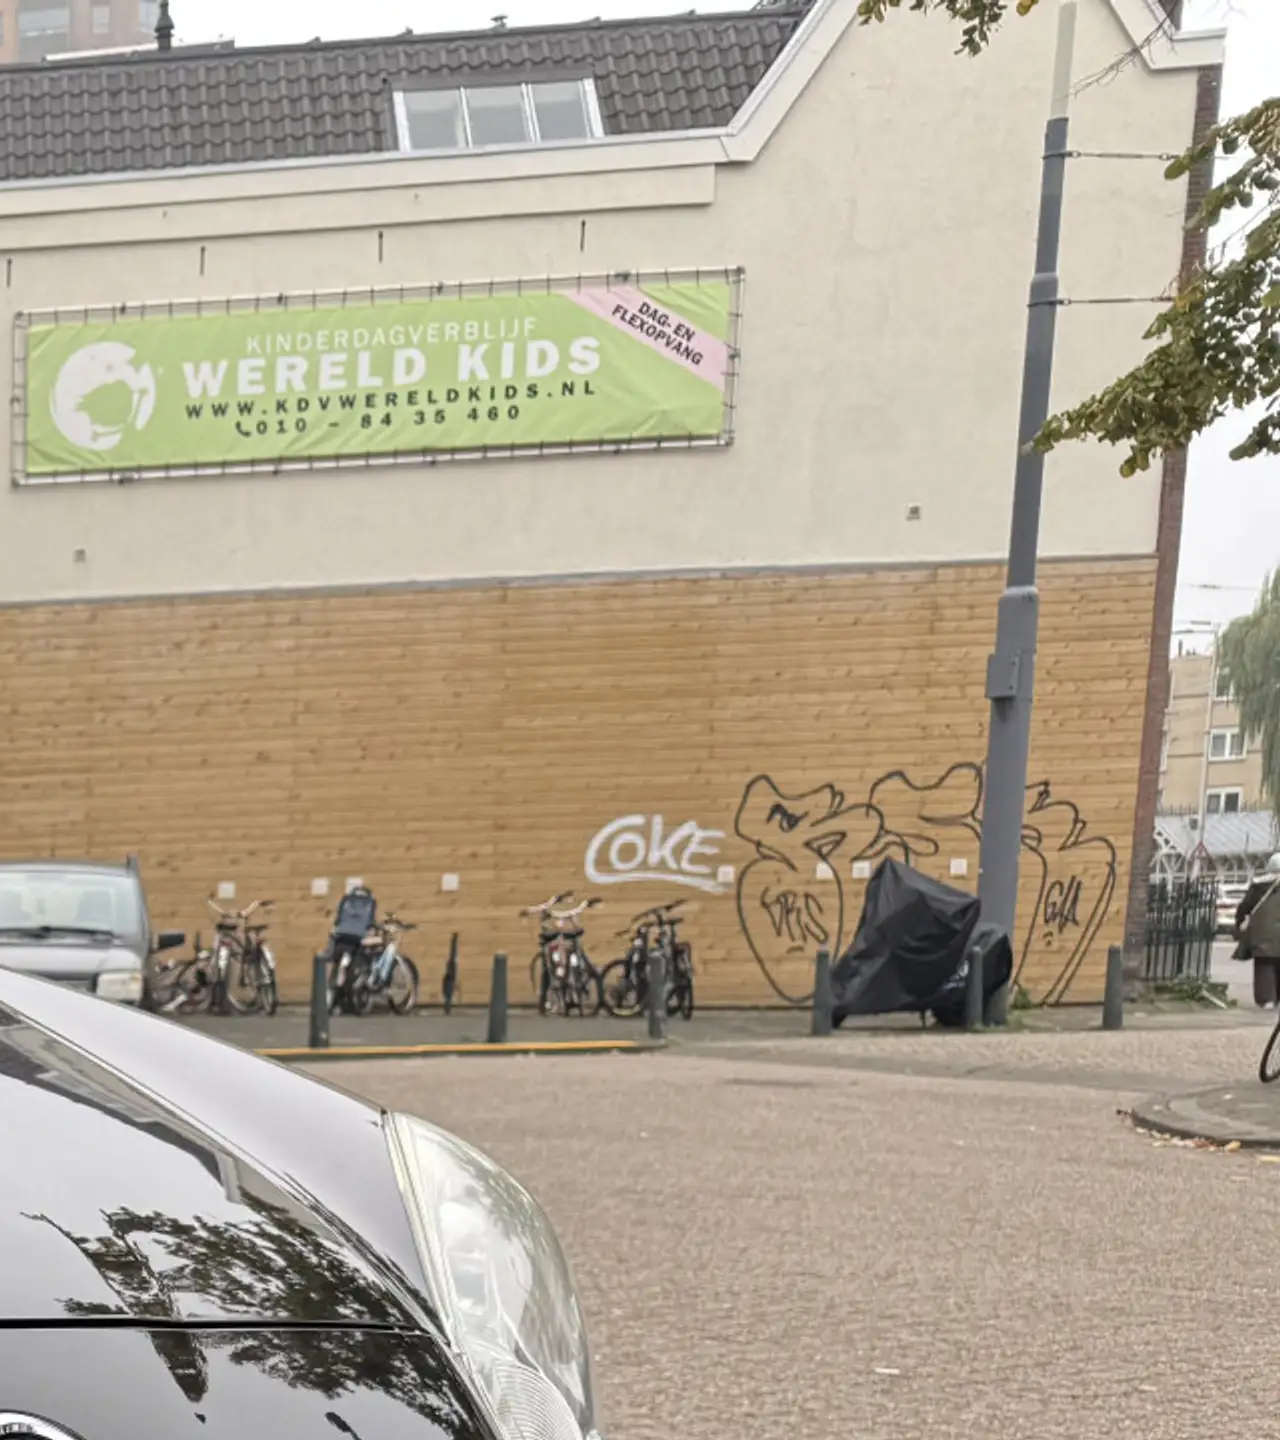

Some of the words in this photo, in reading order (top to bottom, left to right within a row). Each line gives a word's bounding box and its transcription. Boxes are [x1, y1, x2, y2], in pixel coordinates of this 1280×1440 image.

[246, 316, 538, 355] KINDERDAGVERBLIJF
[611, 303, 704, 367] FLEXOPVANG
[637, 300, 672, 329] DAG-
[673, 322, 696, 342] EN
[182, 348, 427, 399] WERELD
[457, 335, 601, 382] KIDS
[186, 379, 597, 419] WWW.KDVWERELDKIDS.NL
[256, 416, 308, 436] 010
[584, 812, 727, 888] COKE
